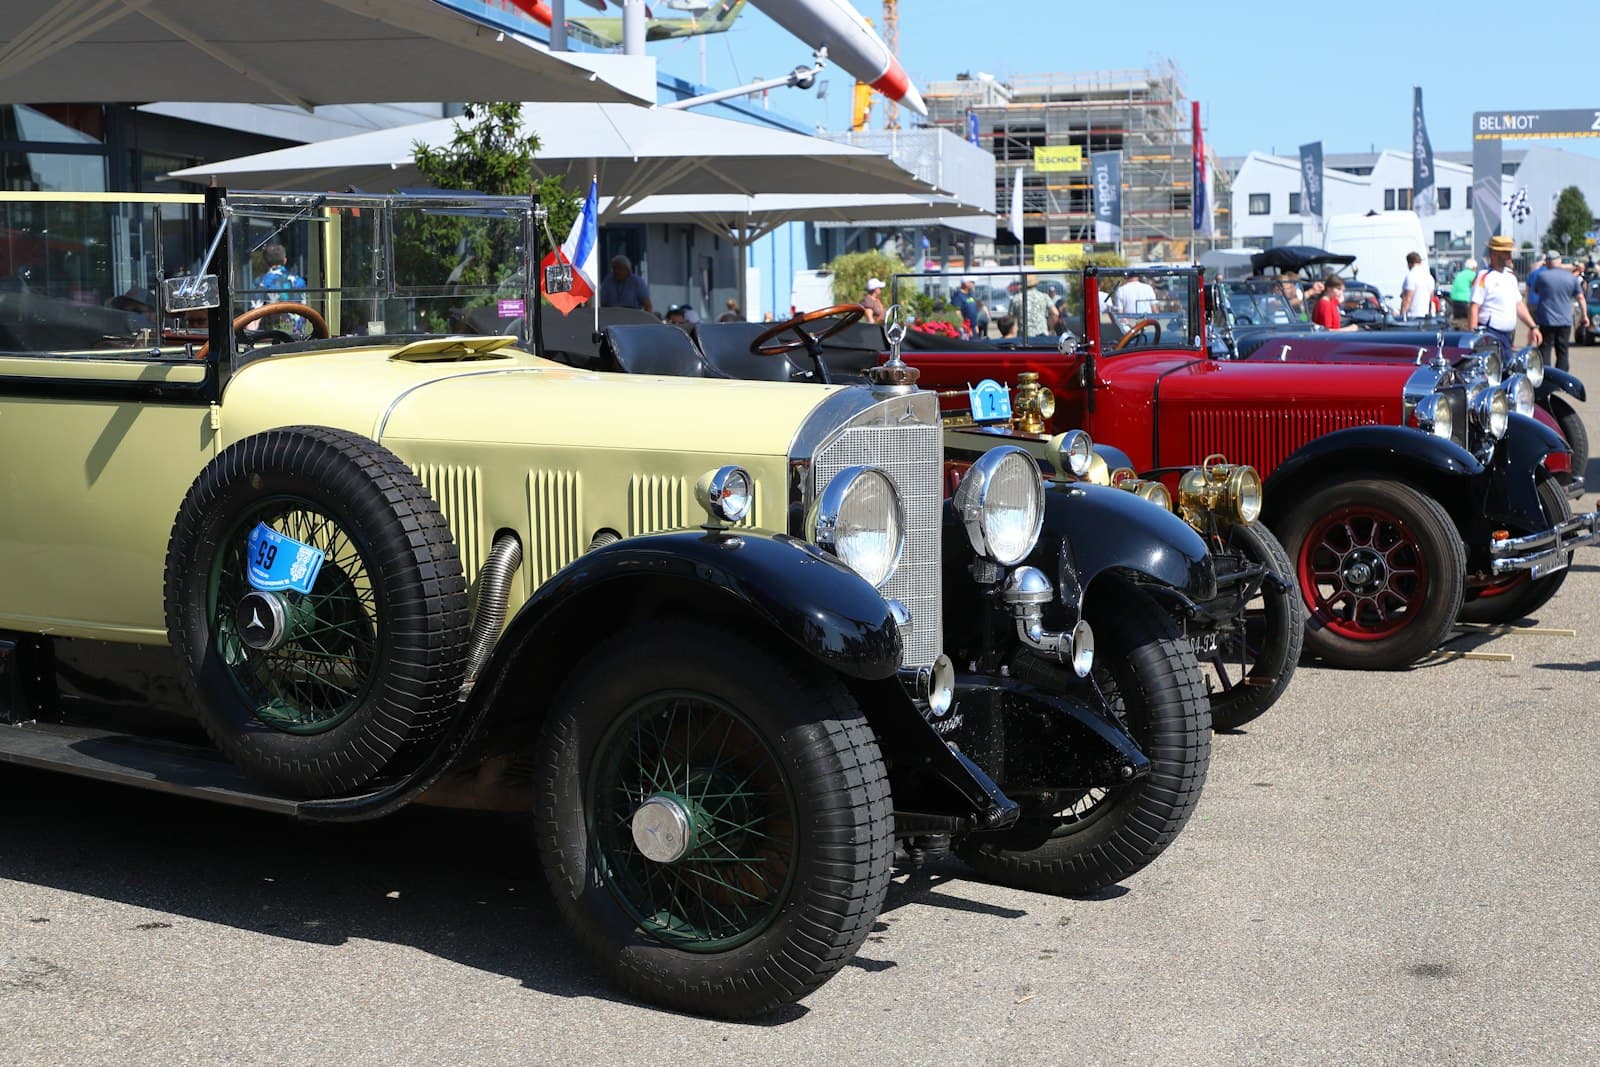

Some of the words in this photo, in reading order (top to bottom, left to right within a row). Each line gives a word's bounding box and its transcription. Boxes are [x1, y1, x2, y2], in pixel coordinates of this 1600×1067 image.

[1046, 155, 1078, 164] SCHICK
[988, 393, 996, 411] 2
[254, 539, 278, 570] 65
